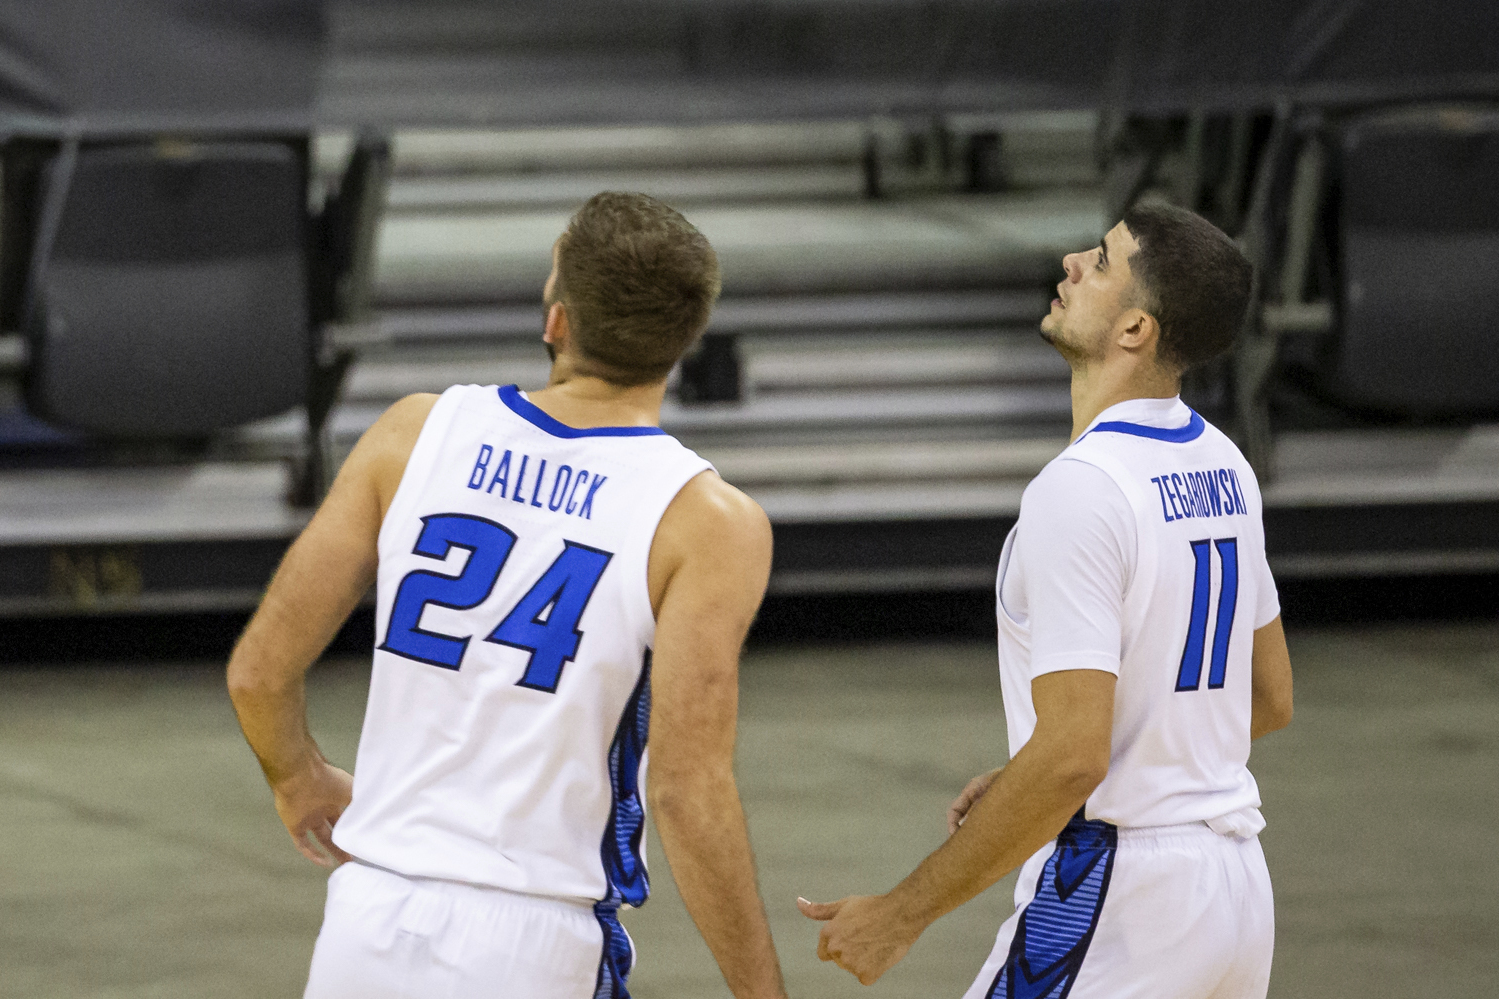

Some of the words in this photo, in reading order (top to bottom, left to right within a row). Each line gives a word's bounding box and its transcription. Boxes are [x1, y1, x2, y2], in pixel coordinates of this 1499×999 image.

[467, 443, 608, 520] BALLOCK
[1150, 468, 1248, 523] ZEGAROWSKI
[376, 513, 614, 694] 24
[1174, 537, 1239, 692] 11
